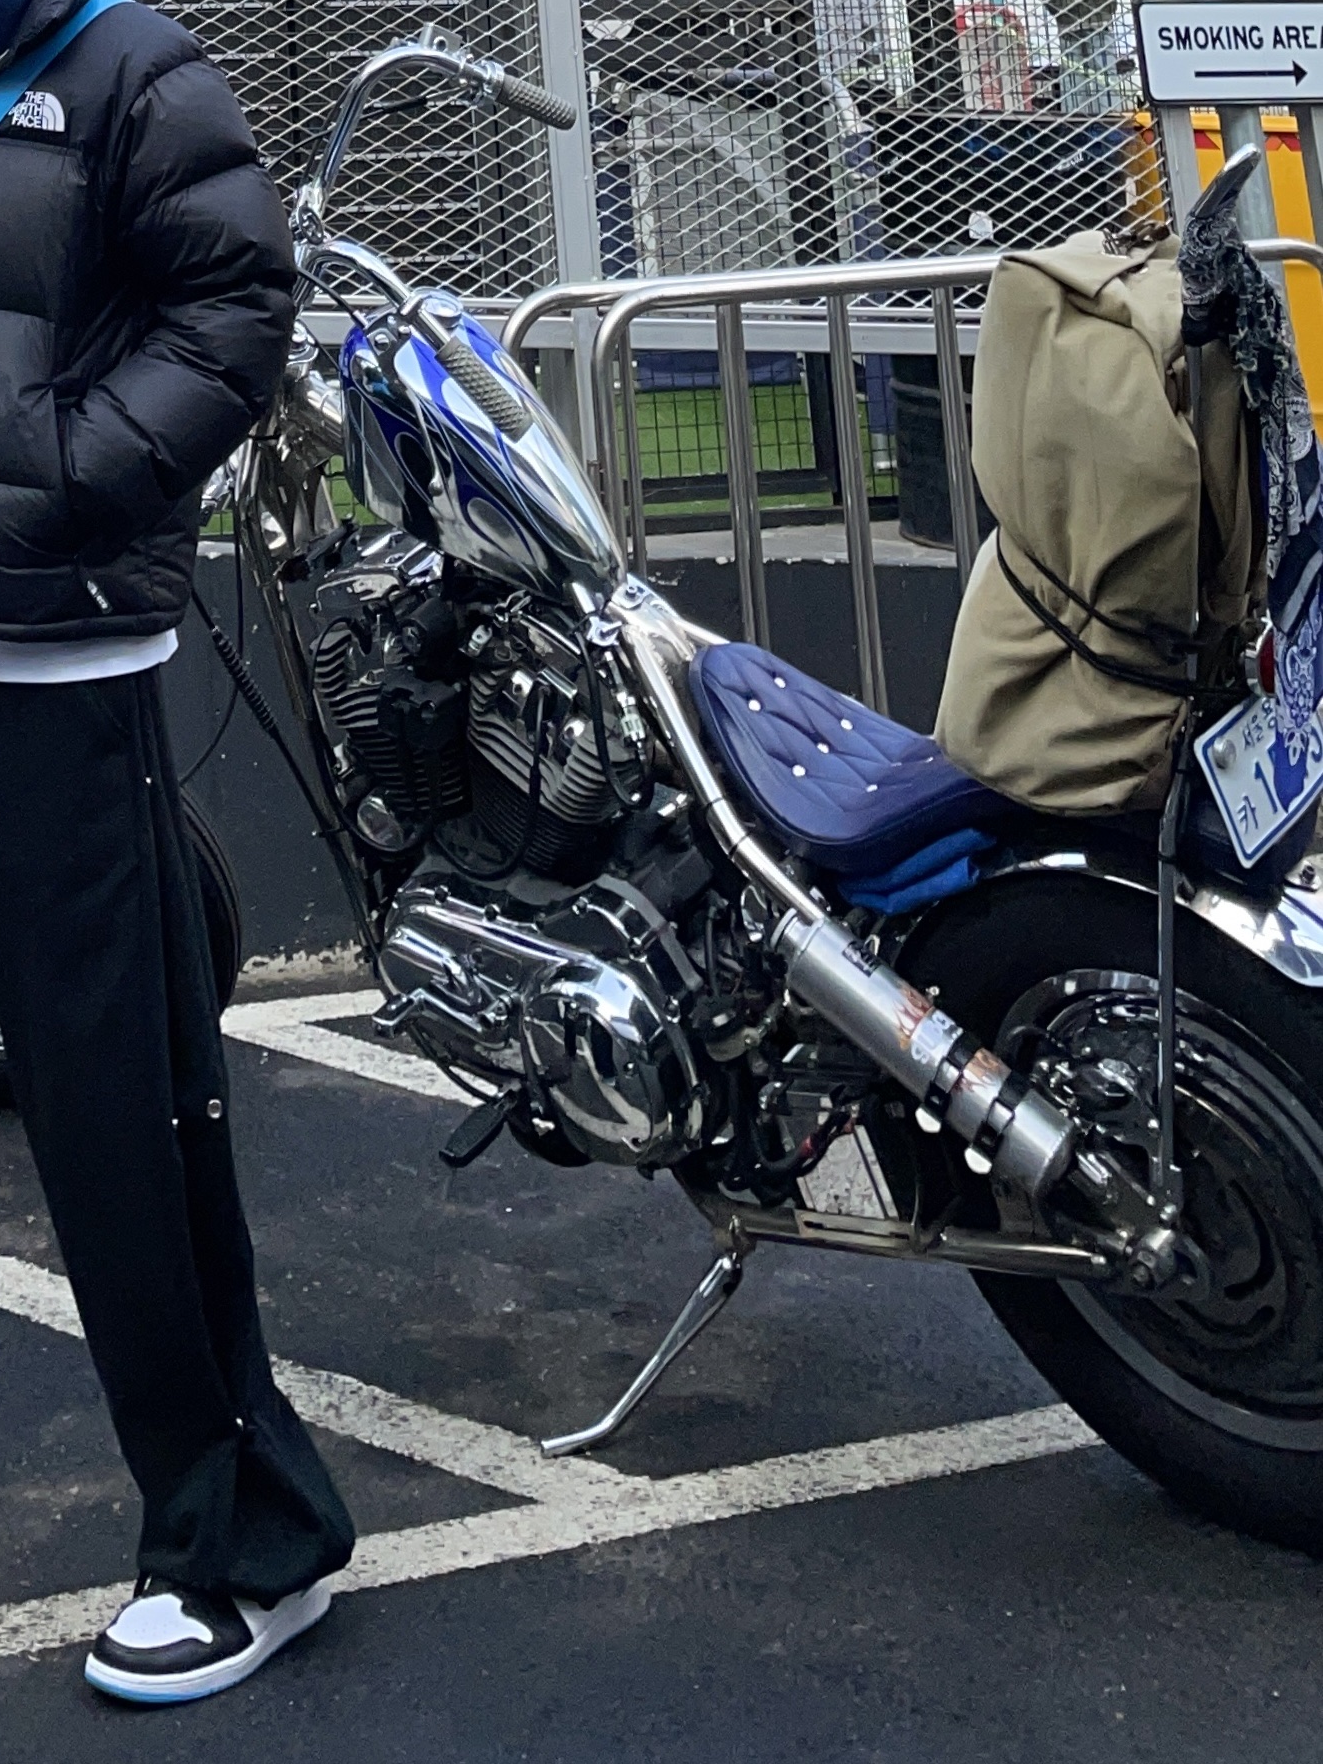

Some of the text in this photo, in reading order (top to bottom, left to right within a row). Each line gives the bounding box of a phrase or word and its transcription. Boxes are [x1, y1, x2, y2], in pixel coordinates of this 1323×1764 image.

[1158, 25, 1323, 51] SMOKING ARE
[24, 90, 45, 104] THE
[11, 114, 43, 129] FACE
